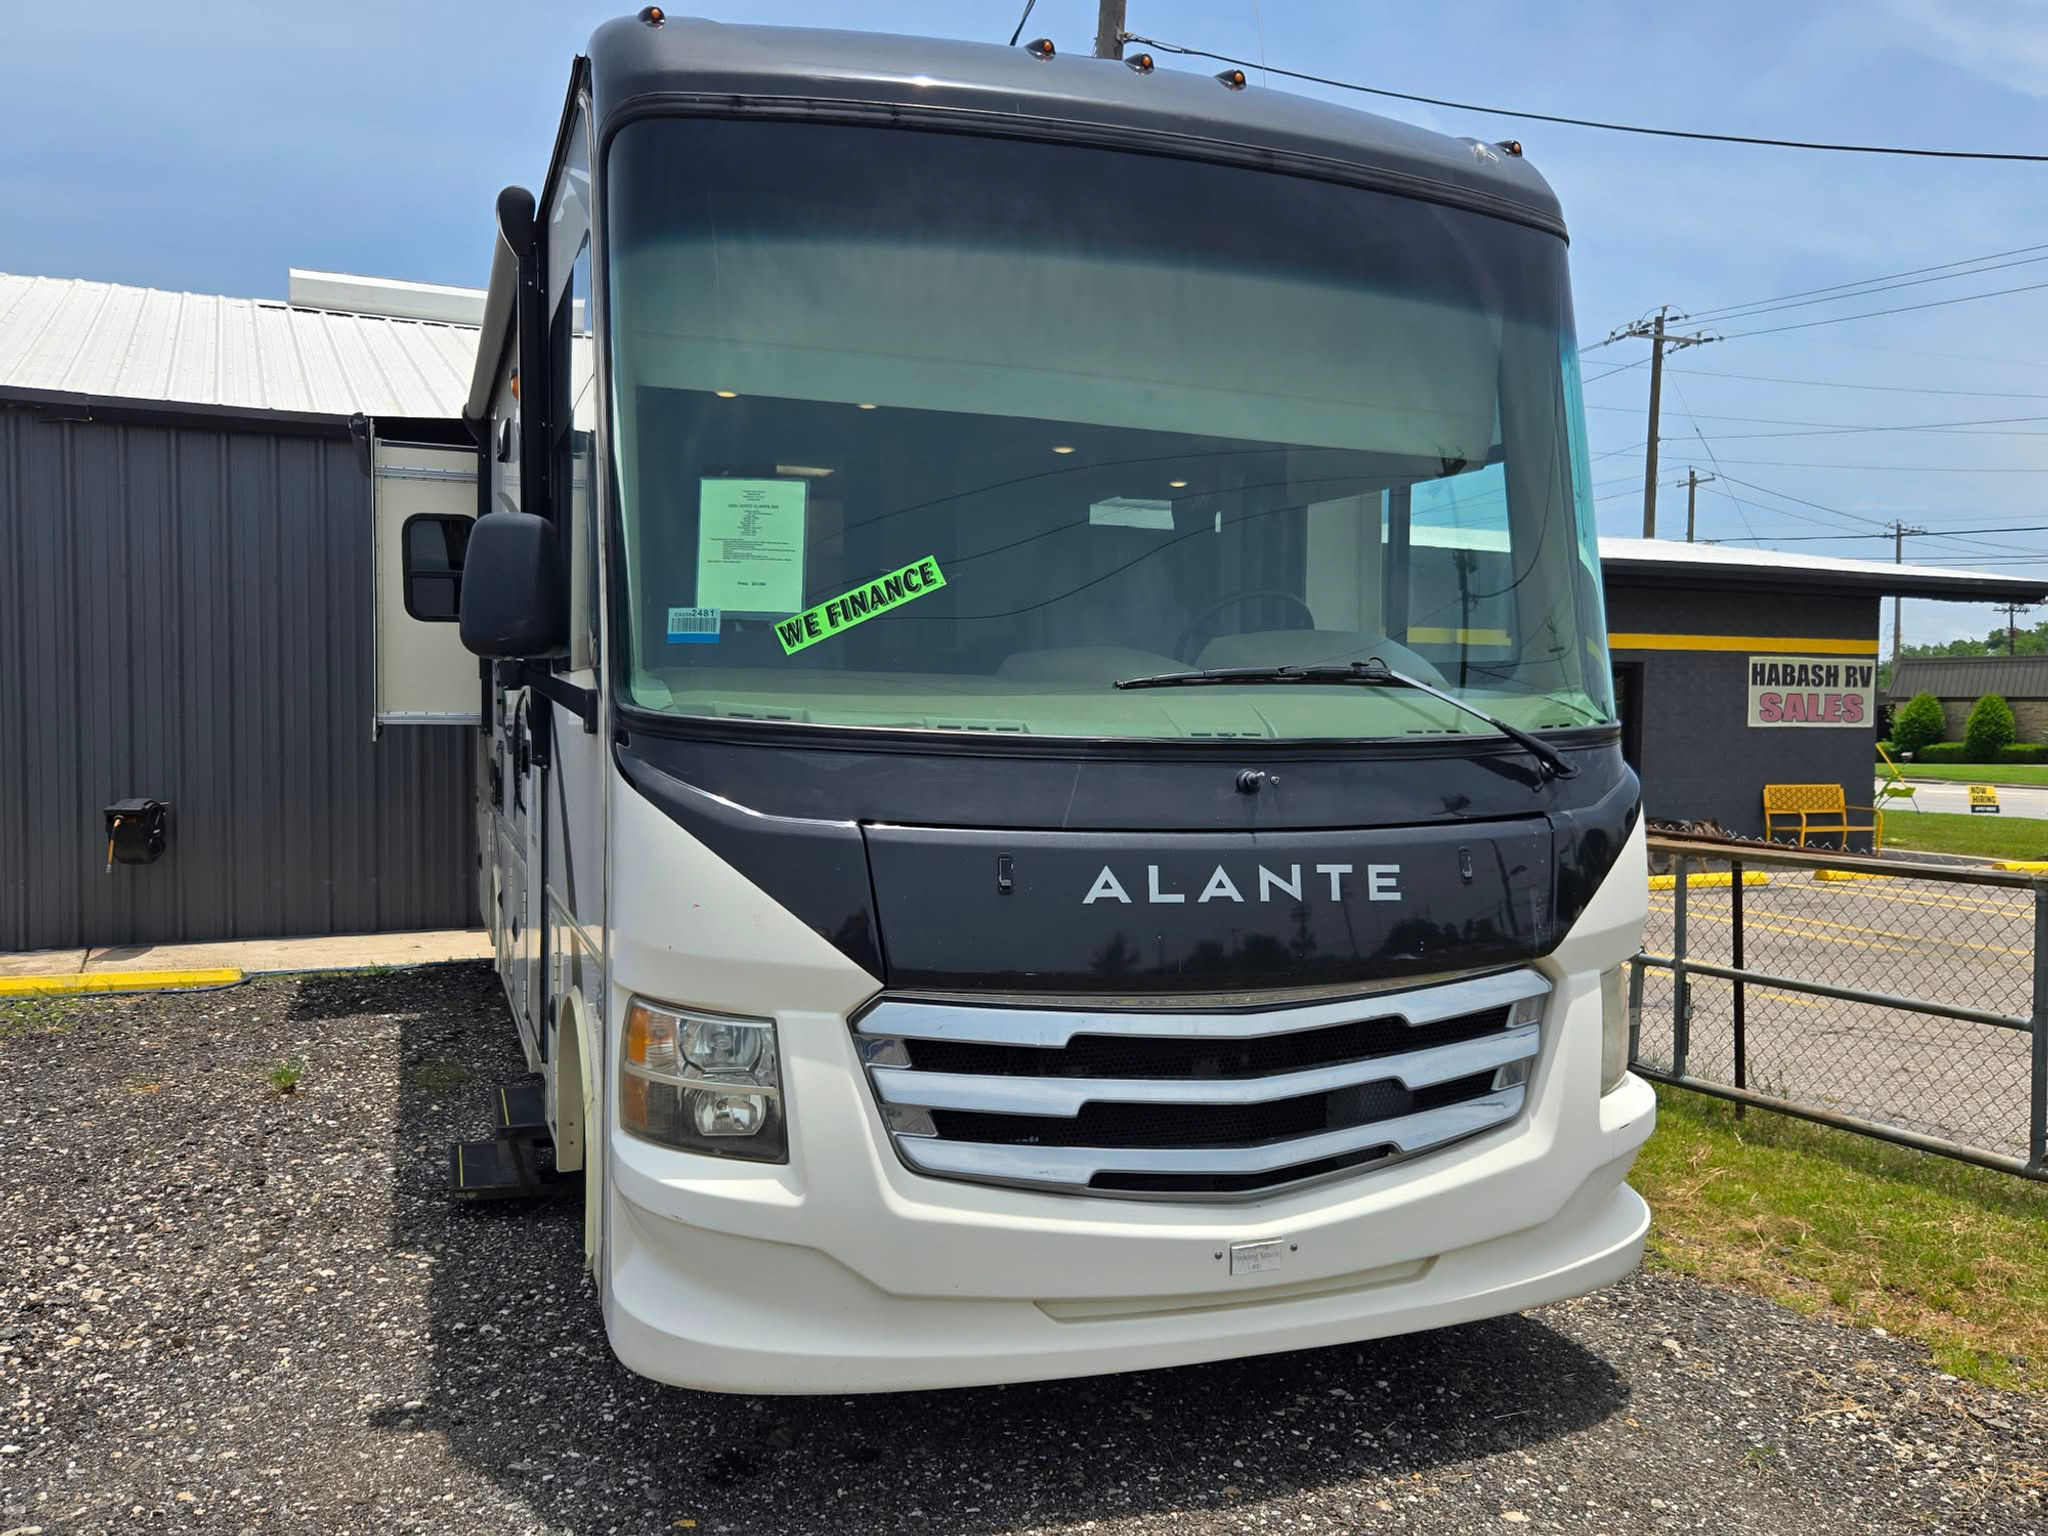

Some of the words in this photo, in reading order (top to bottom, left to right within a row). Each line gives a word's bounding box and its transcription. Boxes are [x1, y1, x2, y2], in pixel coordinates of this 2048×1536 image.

[778, 611, 822, 648] WE
[825, 561, 937, 629] FINANCE
[1751, 663, 1839, 688] HABASH
[1845, 665, 1873, 688] RV
[1760, 692, 1864, 723] SALES
[1970, 786, 1987, 794] NOW
[1972, 795, 1997, 803] HIRING
[1082, 864, 1402, 904] ALANTE
